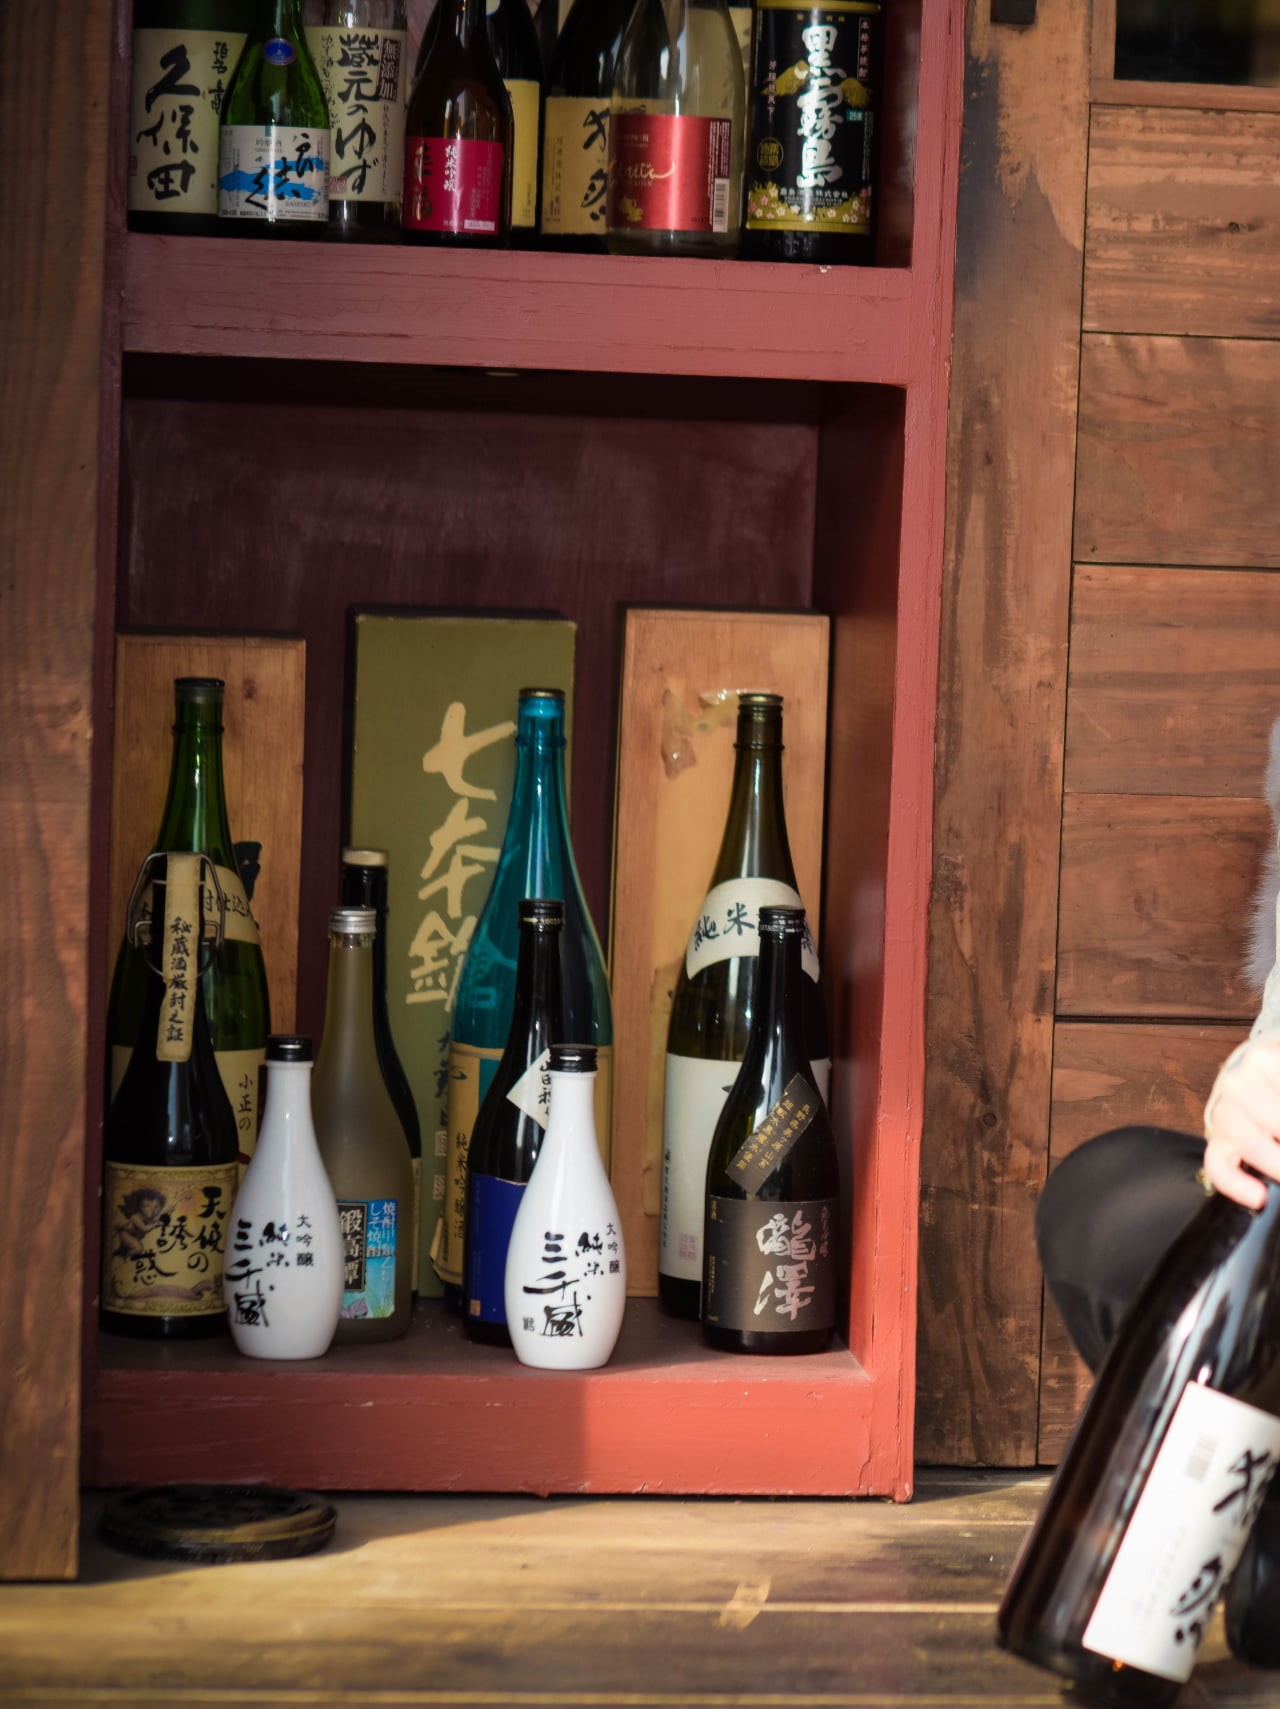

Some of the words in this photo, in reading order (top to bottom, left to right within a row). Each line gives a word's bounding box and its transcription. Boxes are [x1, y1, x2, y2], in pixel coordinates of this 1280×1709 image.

[380, 38, 399, 102] 無添加
[136, 43, 201, 201] 久保田
[335, 33, 379, 195] 蔵元のゆず
[797, 24, 847, 189] 黒霧島
[237, 1073, 254, 1131] 小正の
[296, 1214, 315, 1267] 大吟醸
[606, 1221, 621, 1274] 大吟醸
